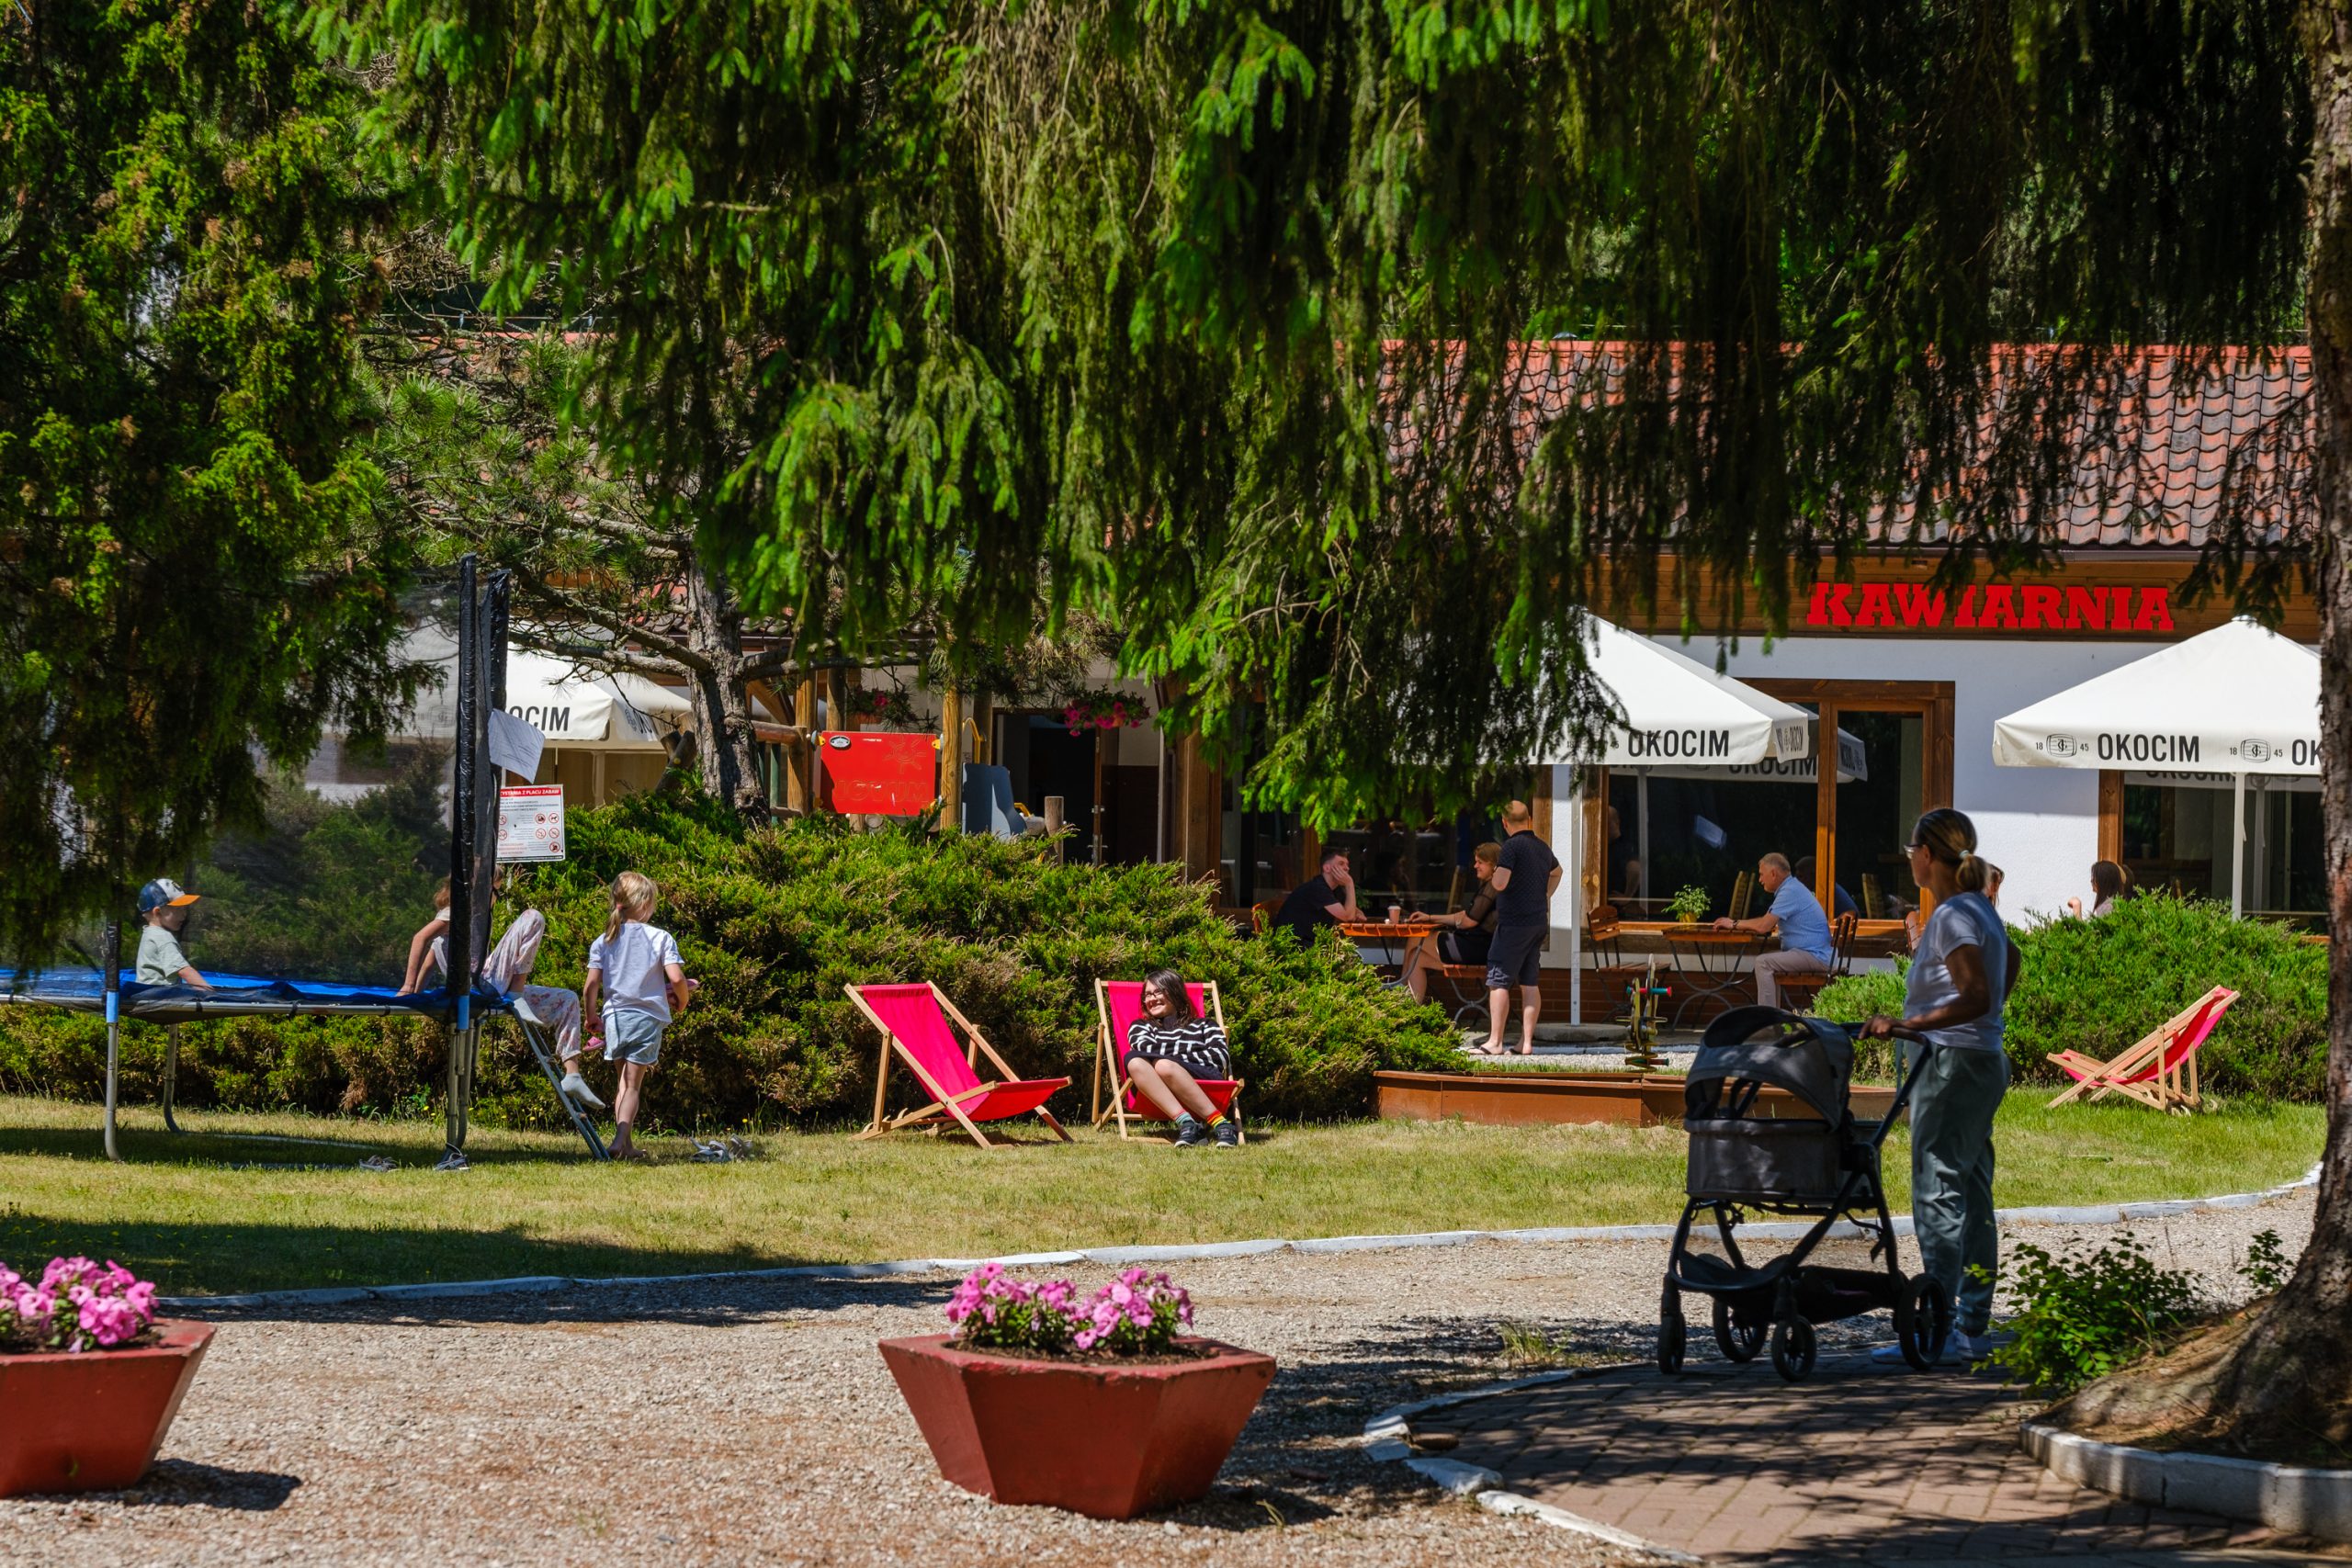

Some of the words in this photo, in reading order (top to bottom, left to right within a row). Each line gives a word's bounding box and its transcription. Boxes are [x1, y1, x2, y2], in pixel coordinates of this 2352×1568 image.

[1806, 581, 2175, 631] KAWIARNIA
[1628, 729, 1730, 758] OKOCIM
[2035, 741, 2044, 751] 18
[2079, 742, 2089, 752] 45
[2098, 732, 2200, 763] OKOCIM
[2229, 746, 2238, 756] 18
[2273, 749, 2283, 758] 45
